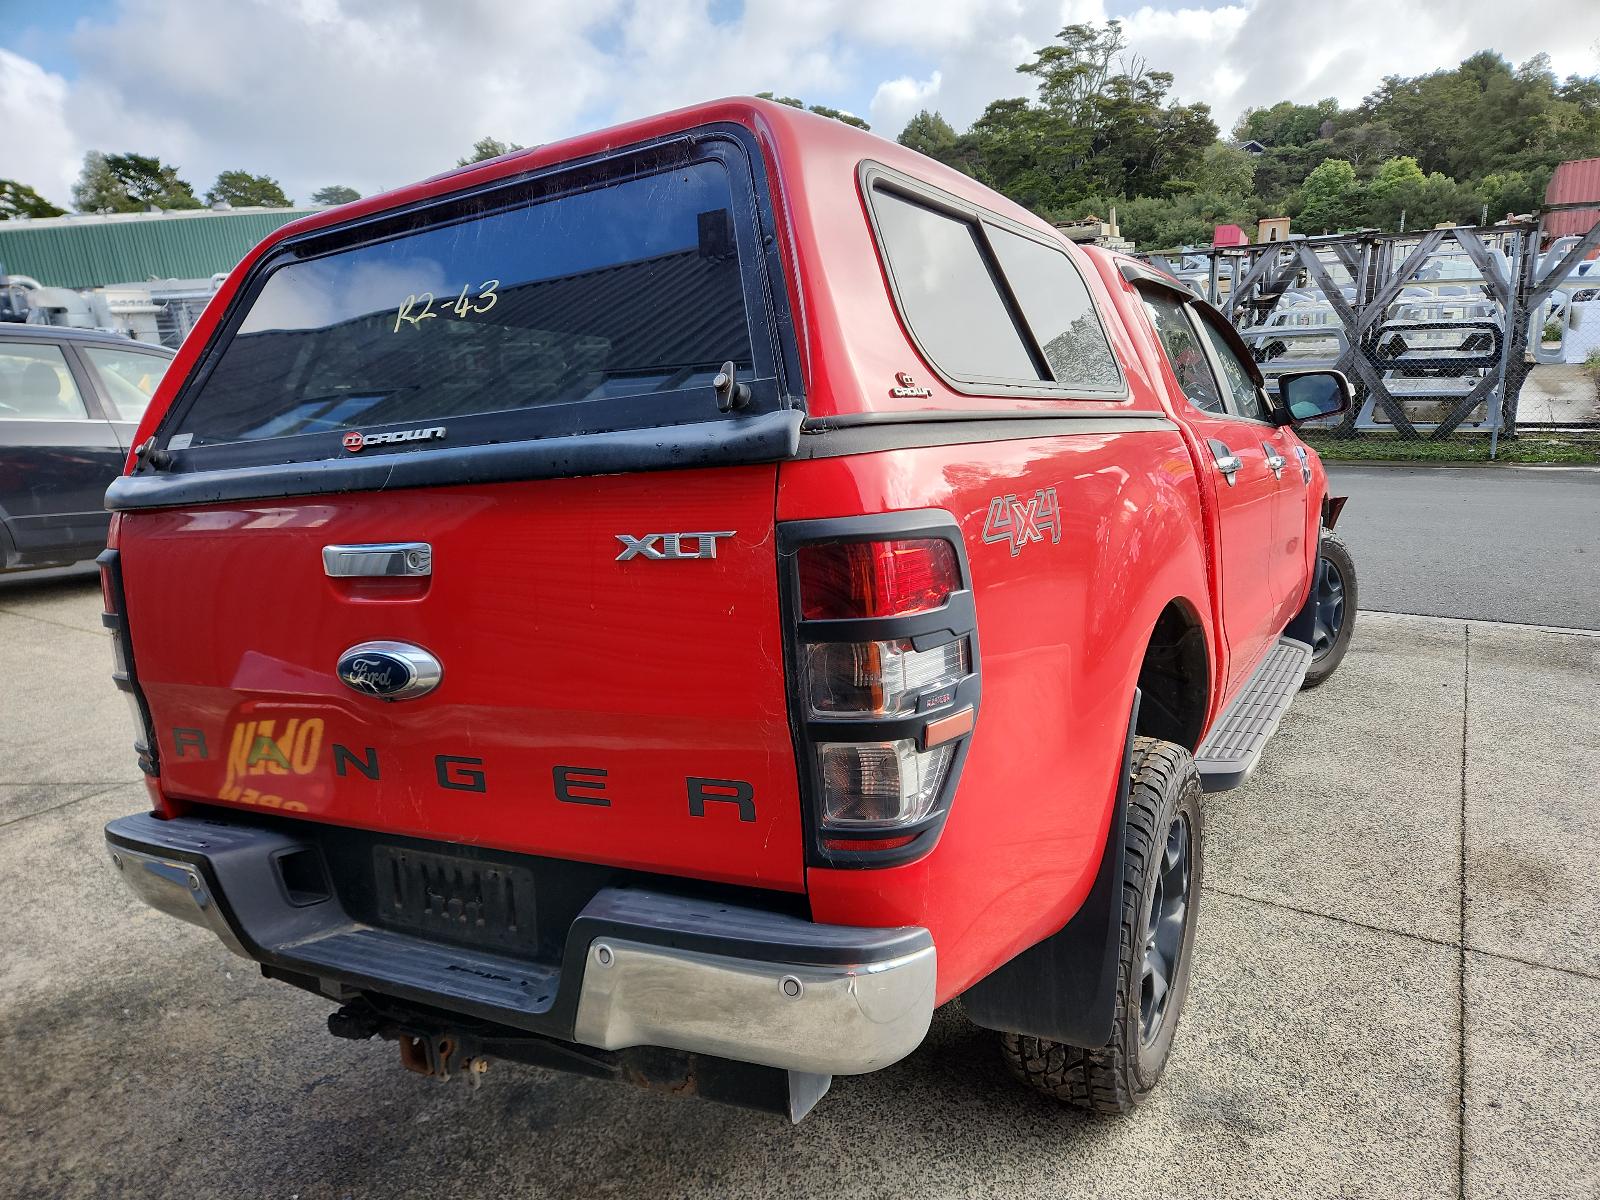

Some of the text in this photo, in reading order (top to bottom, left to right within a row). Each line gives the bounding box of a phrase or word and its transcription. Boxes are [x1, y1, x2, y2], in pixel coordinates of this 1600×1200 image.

[394, 279, 500, 333] R2-43
[362, 426, 447, 446] CROWN
[614, 530, 738, 561] XLT
[350, 658, 392, 689] Ford
[172, 726, 757, 823] RANGER
